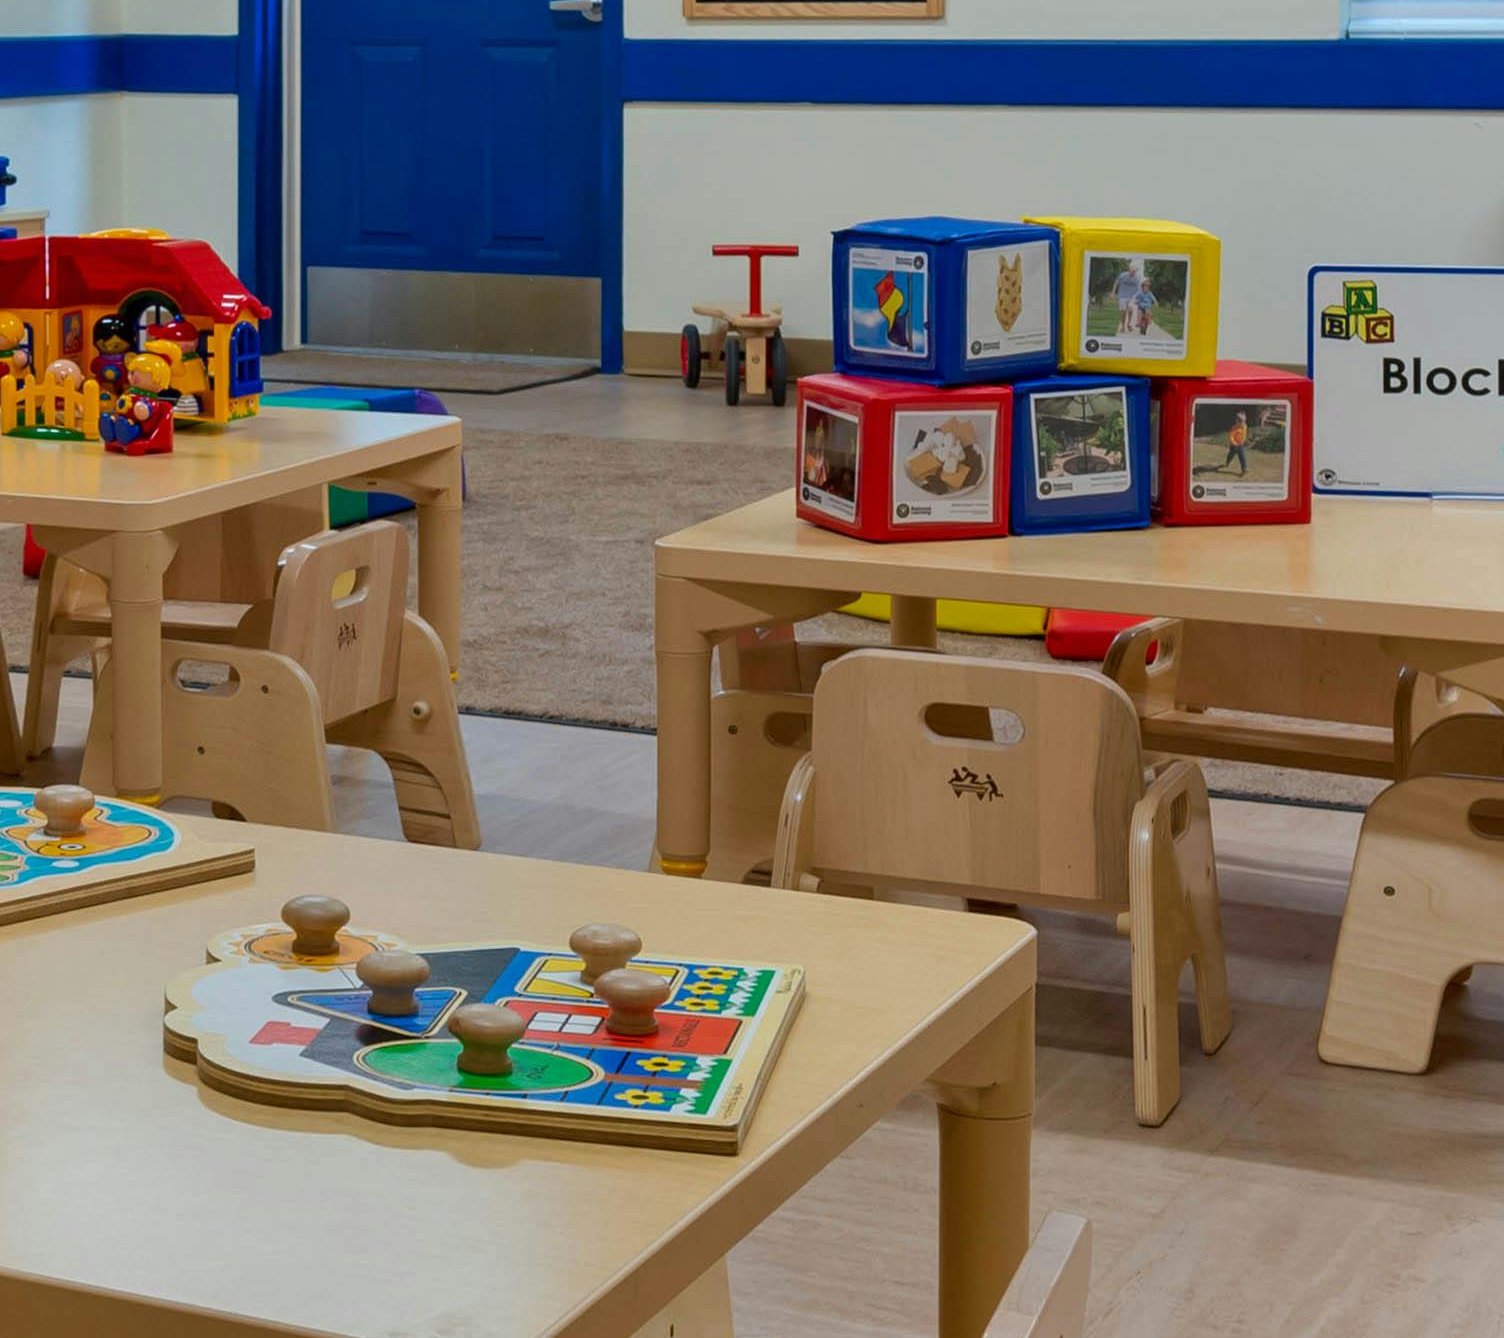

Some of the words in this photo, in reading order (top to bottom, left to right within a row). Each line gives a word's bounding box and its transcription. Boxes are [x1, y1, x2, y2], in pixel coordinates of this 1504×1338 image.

[1353, 289, 1371, 308] A
[1326, 319, 1345, 336] B
[1370, 320, 1389, 339] C
